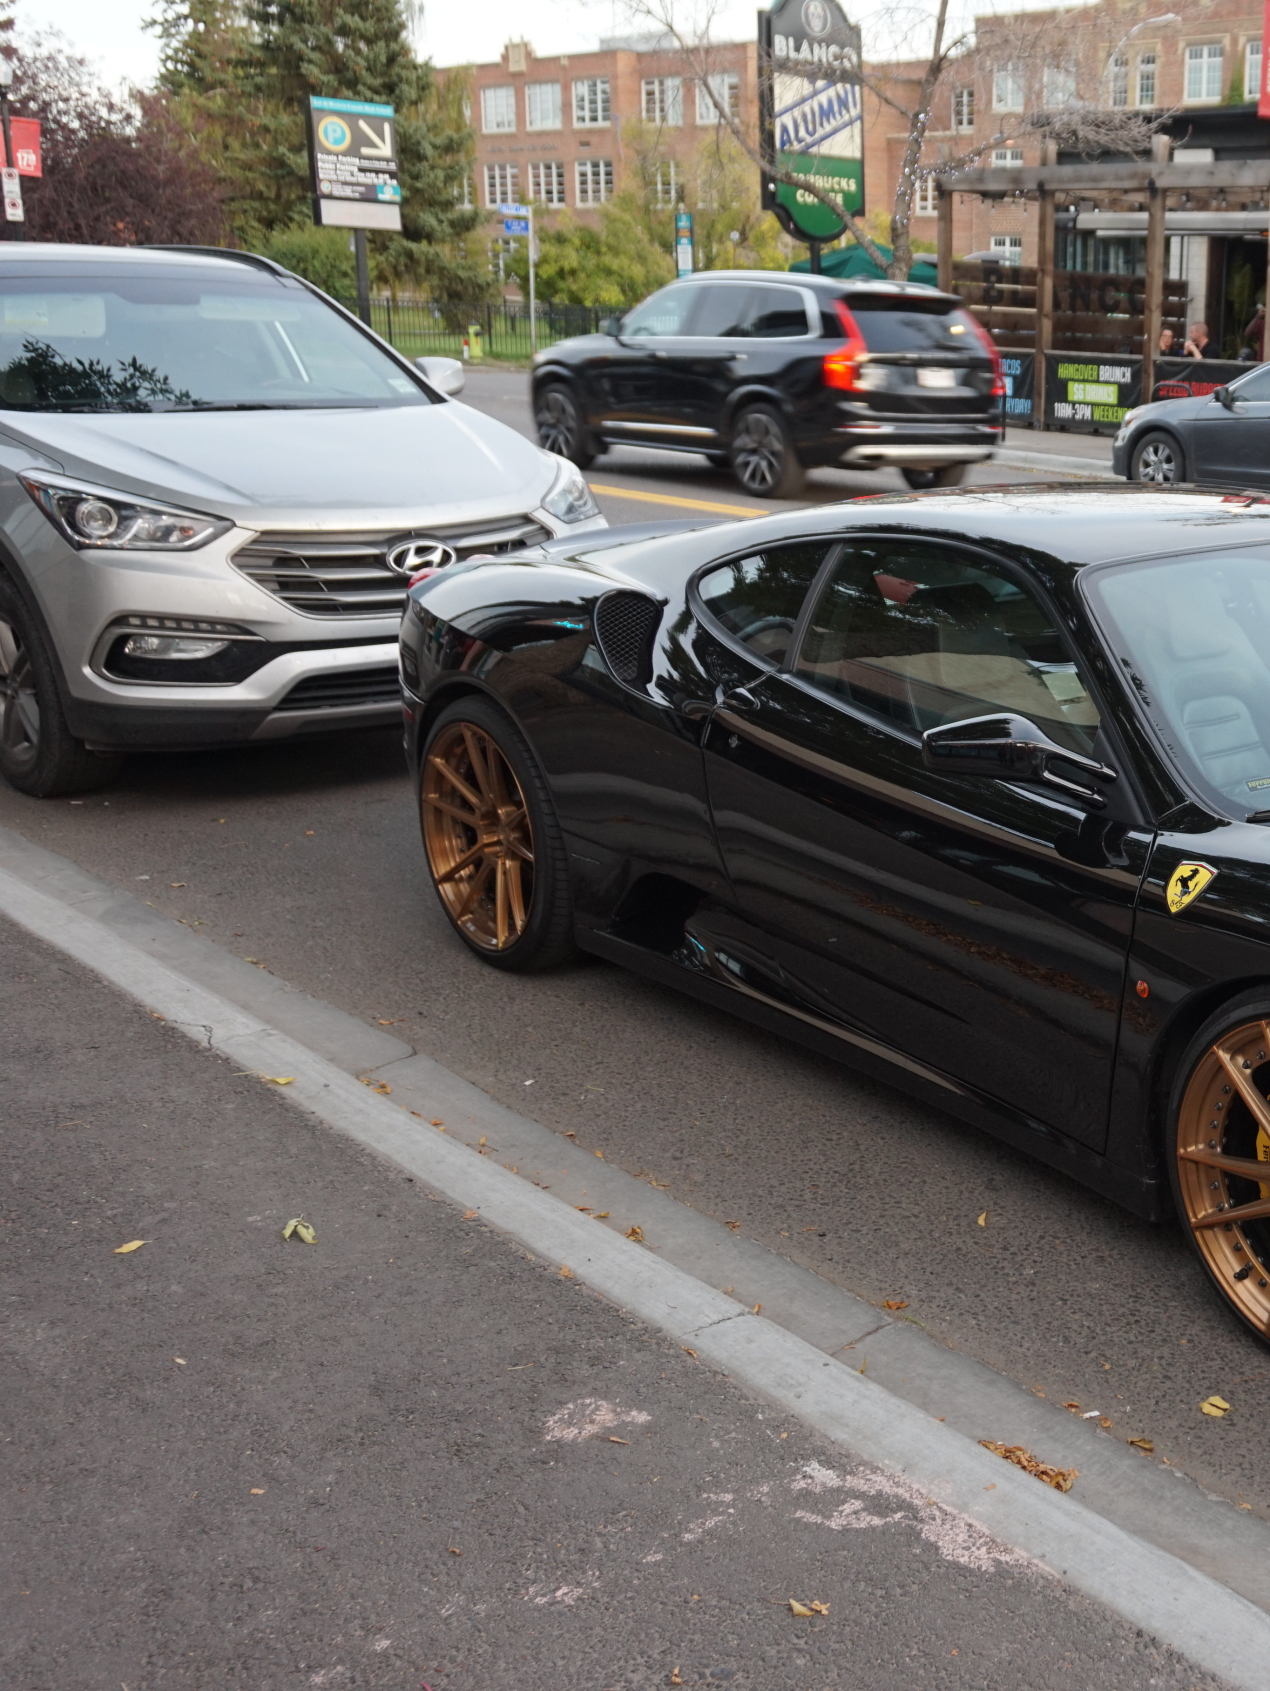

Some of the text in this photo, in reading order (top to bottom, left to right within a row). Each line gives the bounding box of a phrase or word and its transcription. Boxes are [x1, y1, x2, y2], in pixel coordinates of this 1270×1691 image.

[774, 34, 859, 70] BLANCO
[779, 84, 858, 150] ALUMNI
[796, 188, 843, 206] COEE
[1058, 363, 1132, 383] HANGOVER BRUNCH
[1073, 383, 1114, 402] $6 DRINKS
[1054, 402, 1132, 422] 11AM-3PM WEEKEN
